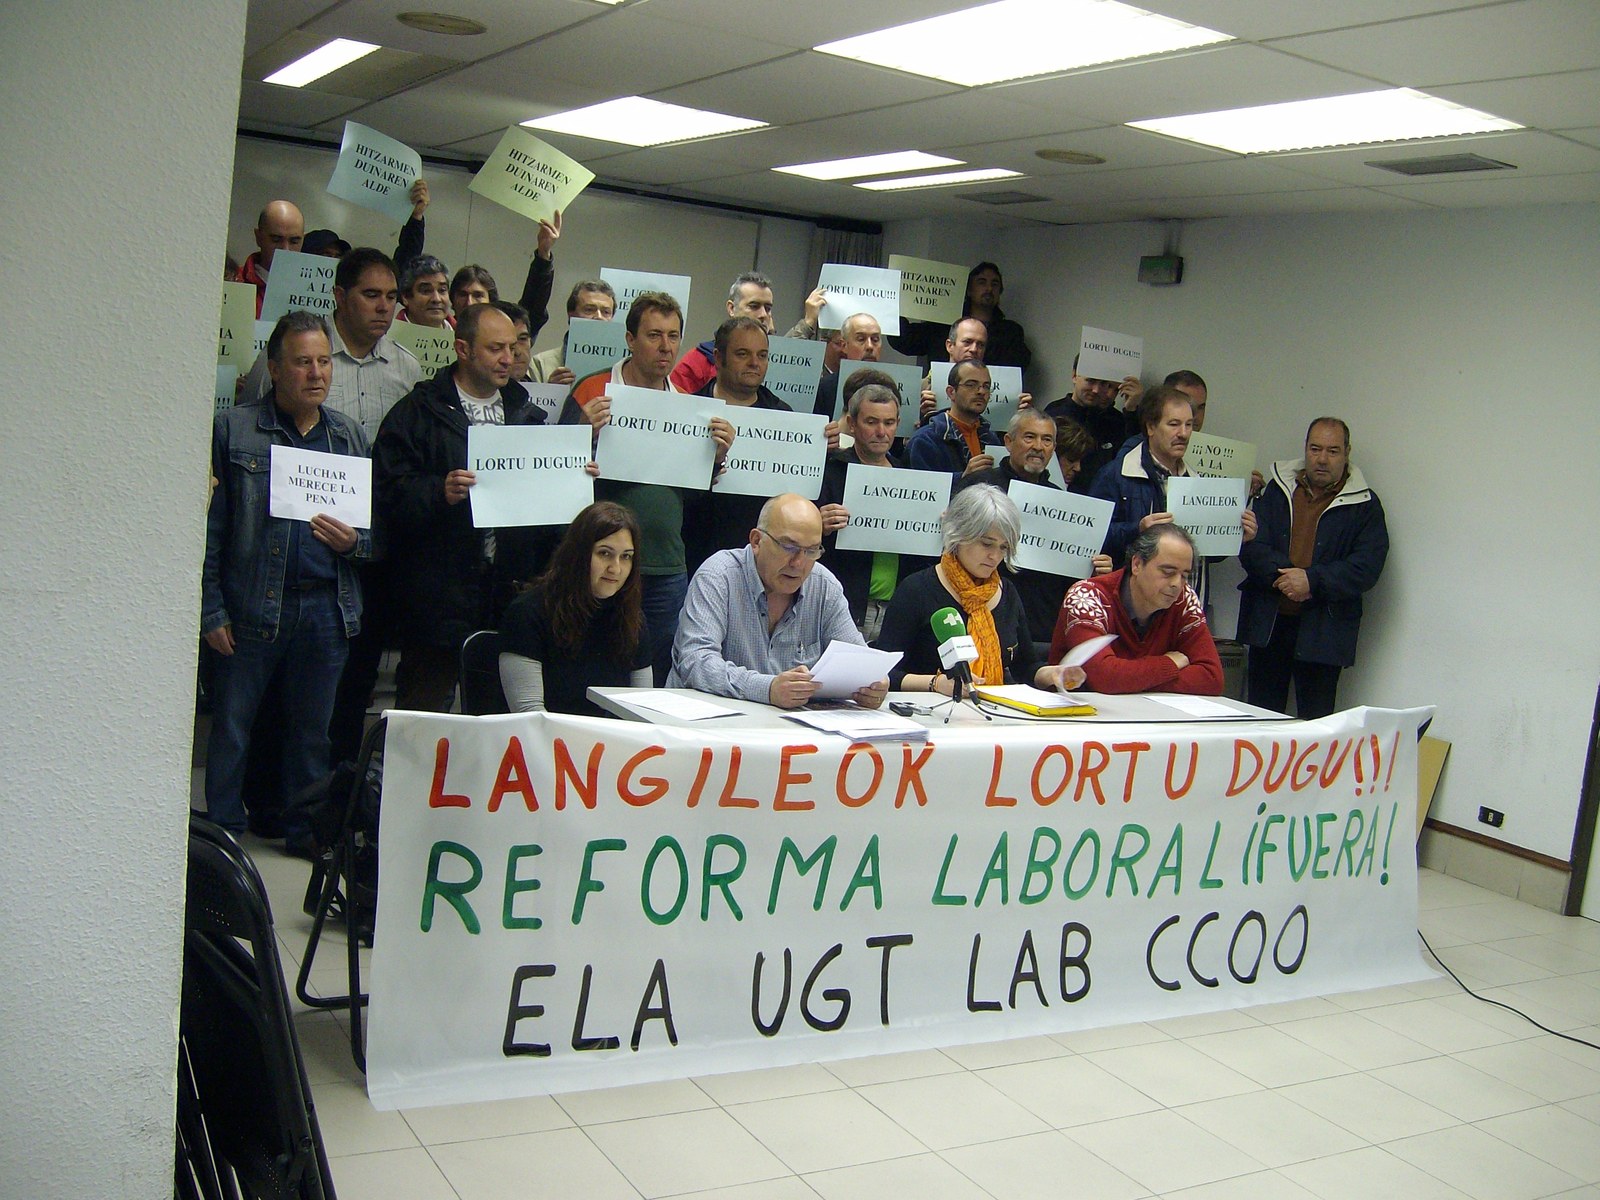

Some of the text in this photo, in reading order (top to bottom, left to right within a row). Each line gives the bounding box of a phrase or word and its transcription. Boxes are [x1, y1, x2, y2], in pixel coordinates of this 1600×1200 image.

[356, 144, 416, 176] HITZARMEN
[509, 148, 572, 185] HITZARMEN
[354, 159, 409, 188] DUINAREN
[505, 163, 559, 194] DUINAREN
[362, 179, 391, 195] ALDE
[510, 183, 541, 201] ALDE
[316, 267, 334, 279] NO
[901, 271, 957, 287] HITZARMEN
[307, 282, 315, 292] A
[858, 287, 896, 300] DUGU!!!
[902, 283, 951, 297] DUINAREN
[913, 297, 938, 306] ALDE
[431, 338, 450, 350] NO
[573, 343, 617, 357] LORTU
[1084, 341, 1141, 359] LORTU DUGU!!!
[421, 352, 450, 364] A LA
[768, 353, 812, 367] GILEOK
[775, 381, 815, 395] DUGU!!!
[995, 394, 1009, 404] LA
[608, 414, 711, 439] LORTU DUGU!!
[736, 425, 813, 445] LANGILEOK
[1205, 444, 1221, 456] NO
[476, 456, 587, 471] LORTU DUGU!!!
[772, 463, 820, 478] DUGU!!!
[1197, 458, 1222, 470] A LA
[298, 465, 346, 480] LUCHAR
[288, 476, 356, 495] MERECE LA
[305, 493, 336, 505] PENA
[863, 485, 938, 502] LANGILEOK
[1182, 495, 1238, 507] LANGILEOK
[1023, 502, 1096, 528] LANGILEOK
[1182, 525, 1242, 536] RTU DUGU!!!
[1018, 534, 1097, 559] RTU DUGU!!!
[429, 735, 934, 813] LANGILEOK
[985, 741, 1199, 808] LORTU
[420, 832, 882, 935] REFORMA
[931, 819, 1224, 908] LABORAL
[503, 904, 1310, 1058] ELA UGT LAB CCOO
